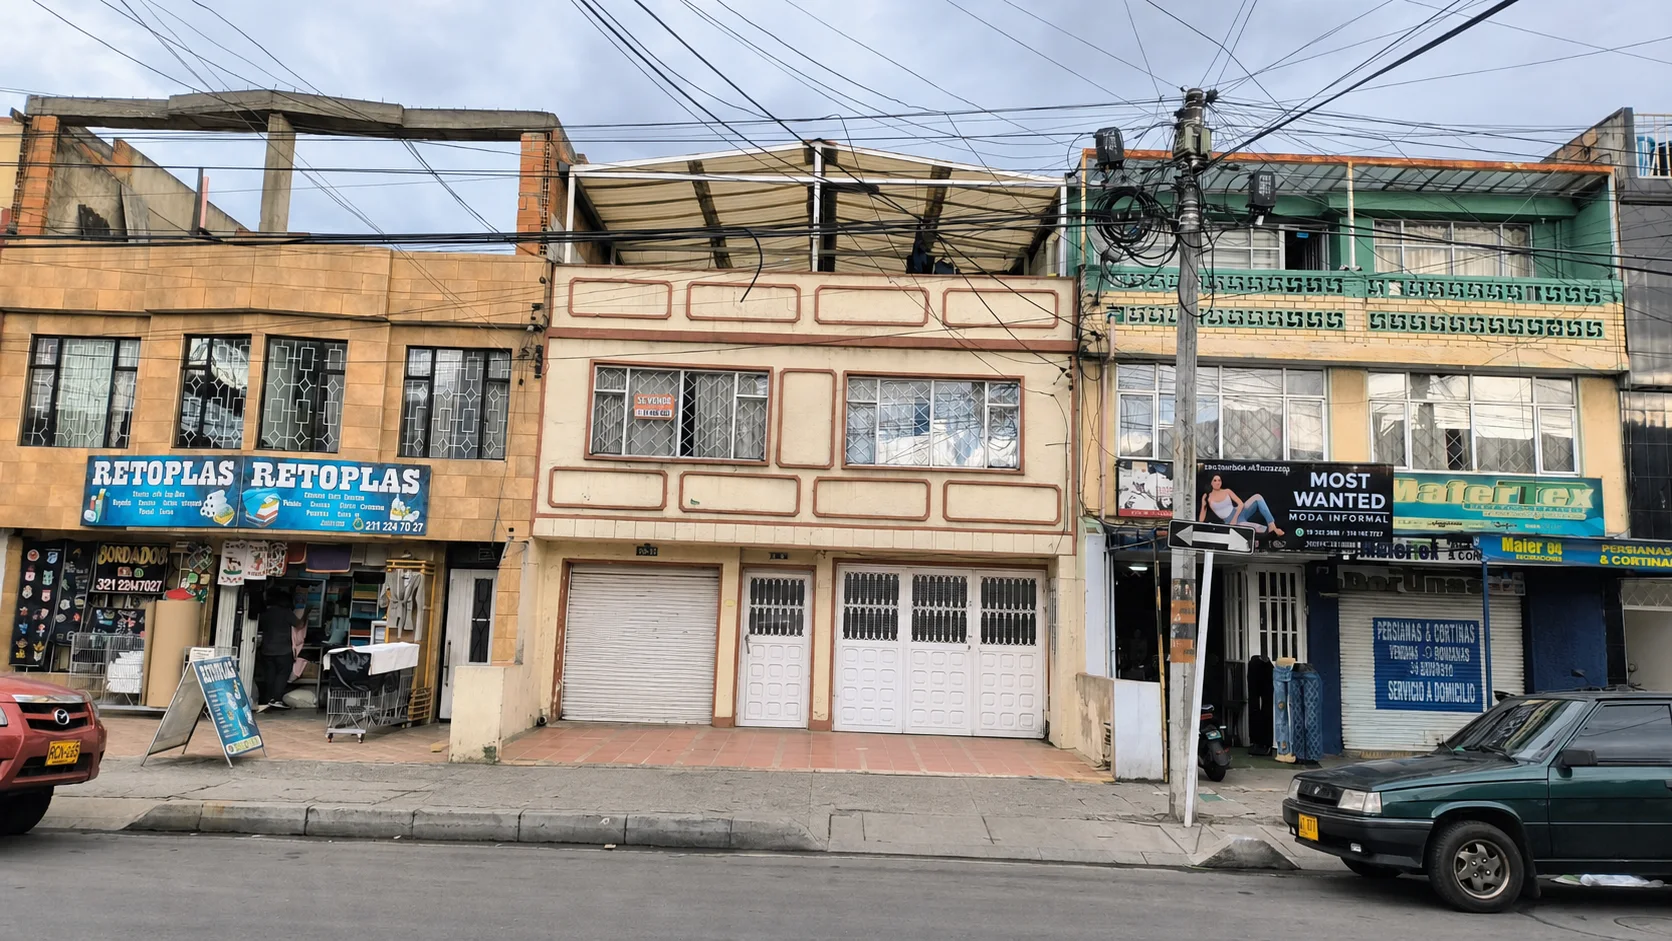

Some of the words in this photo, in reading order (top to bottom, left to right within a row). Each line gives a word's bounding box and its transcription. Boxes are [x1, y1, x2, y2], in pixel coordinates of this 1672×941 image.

[92, 460, 234, 486] RETOPLAS
[251, 461, 420, 495] RETOPLAS
[1310, 472, 1371, 489] MOST
[1293, 491, 1386, 509] WANTED
[1289, 513, 1323, 522] MODA
[1329, 514, 1389, 524] INFORMAL
[1602, 544, 1672, 556] PERSIANAS
[1600, 555, 1609, 565] &
[1611, 555, 1672, 568] CORTINA
[95, 578, 116, 591] 321
[1377, 621, 1422, 642] PERSIANAS
[1434, 623, 1475, 643] CORTINAS
[1388, 680, 1424, 701] SERVICIO
[1426, 681, 1433, 702] A
[1434, 682, 1476, 703] DOMICILIO
